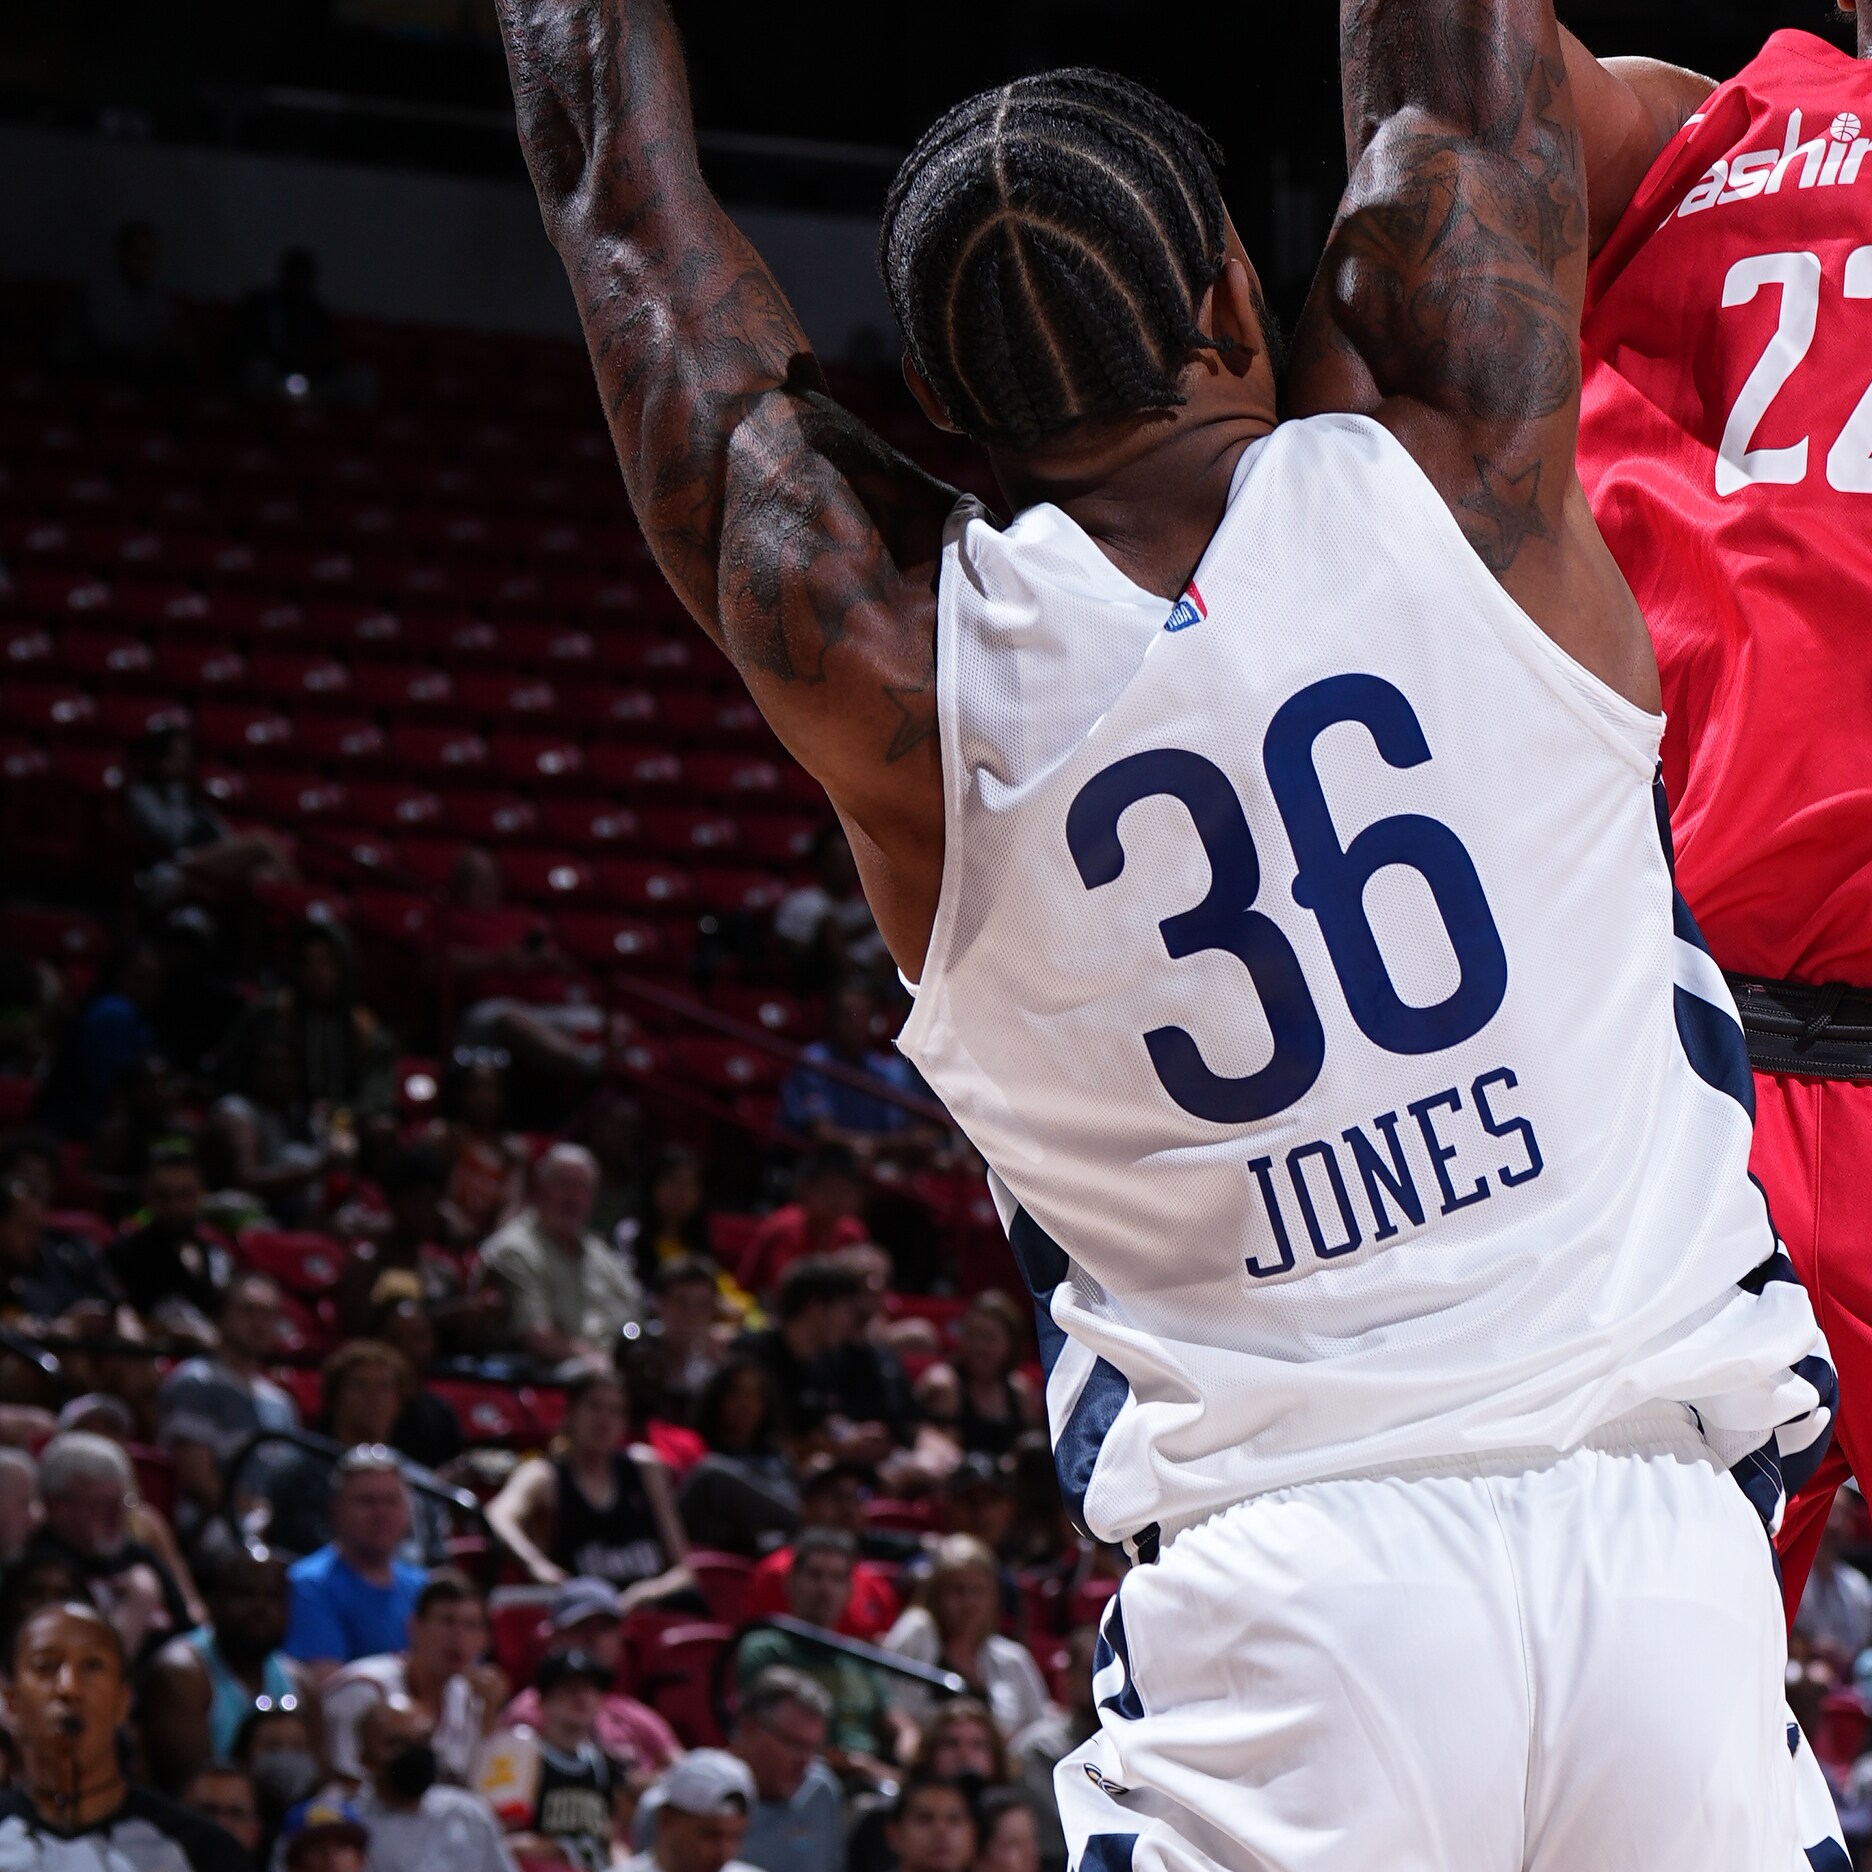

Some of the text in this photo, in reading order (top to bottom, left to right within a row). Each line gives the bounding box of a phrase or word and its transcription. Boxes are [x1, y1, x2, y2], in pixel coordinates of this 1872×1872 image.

[1167, 603, 1193, 631] NBA
[1065, 673, 1508, 1124] 36
[1245, 1066, 1544, 1279] JONES
